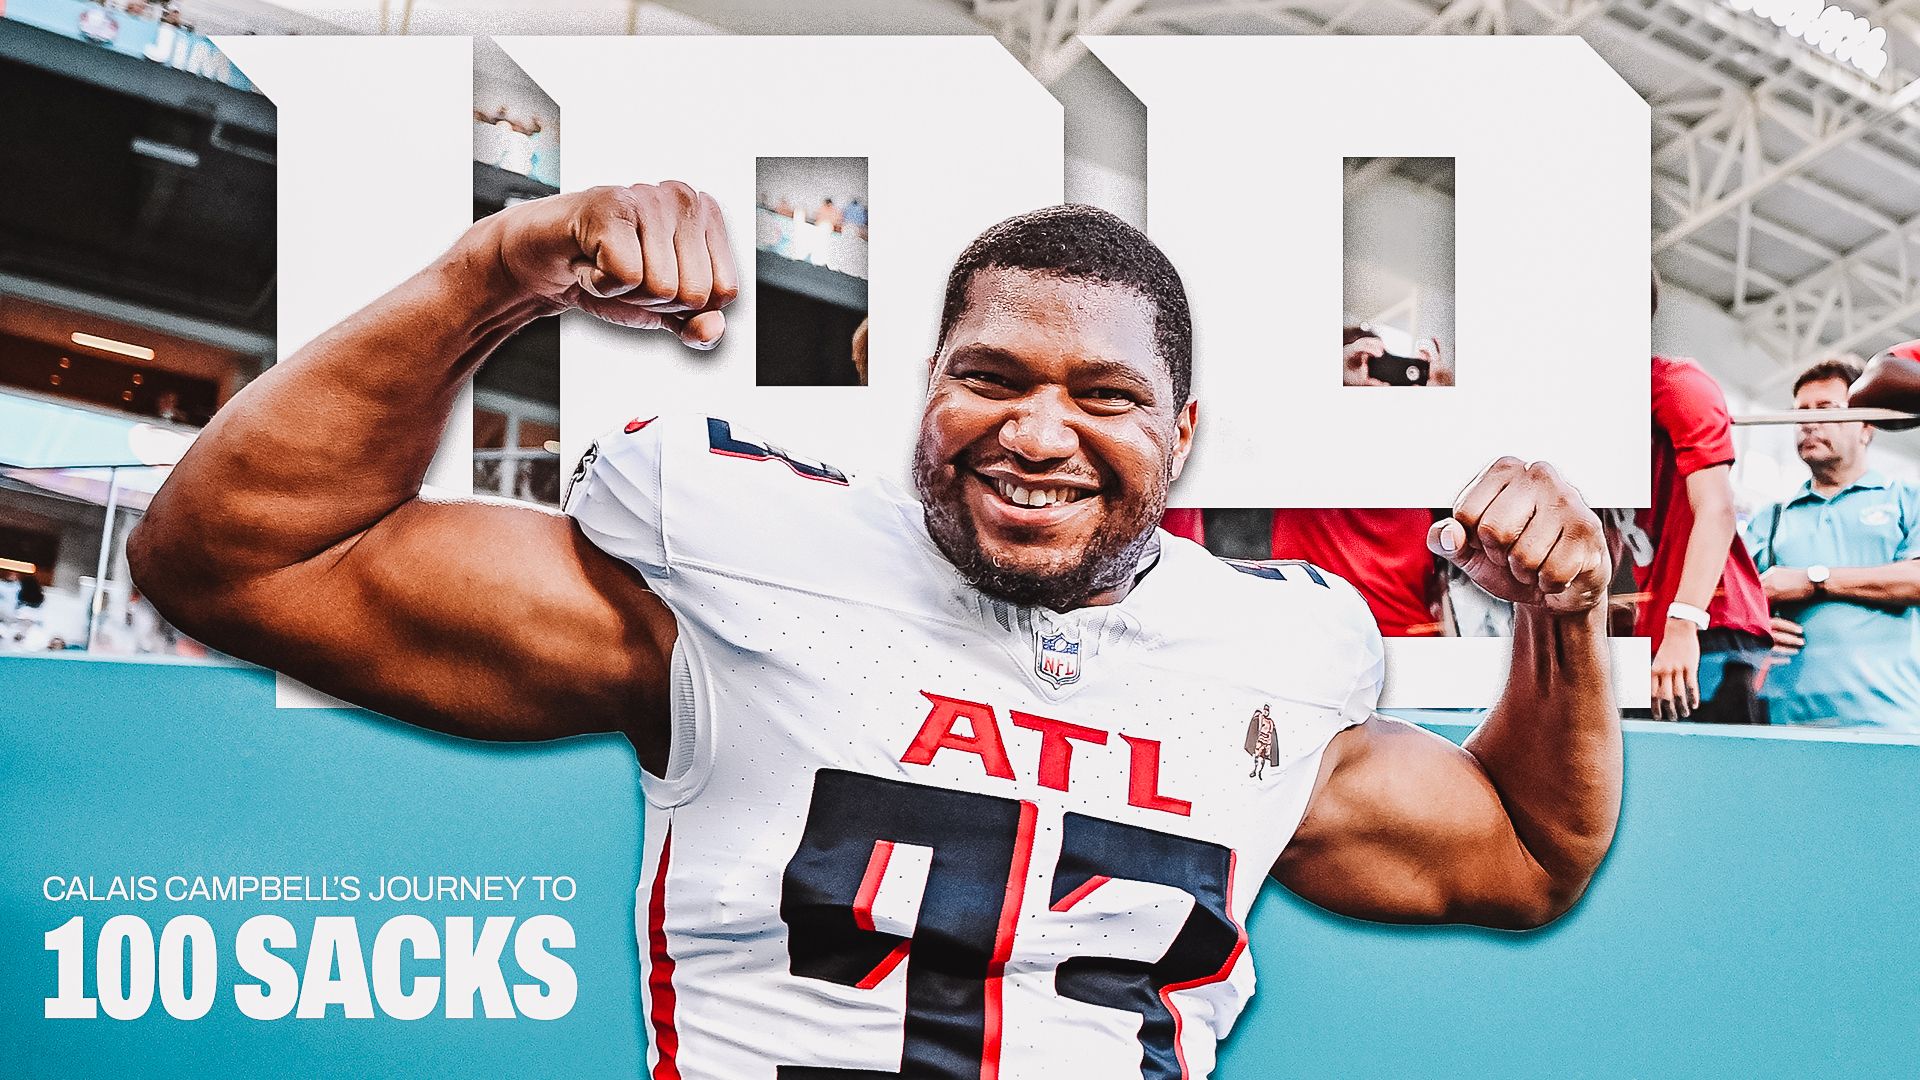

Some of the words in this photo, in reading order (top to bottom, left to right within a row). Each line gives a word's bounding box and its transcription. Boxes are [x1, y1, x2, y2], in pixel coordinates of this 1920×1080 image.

[1043, 655, 1075, 677] NFL
[900, 689, 1192, 816] ATL
[776, 768, 1248, 1080] 93
